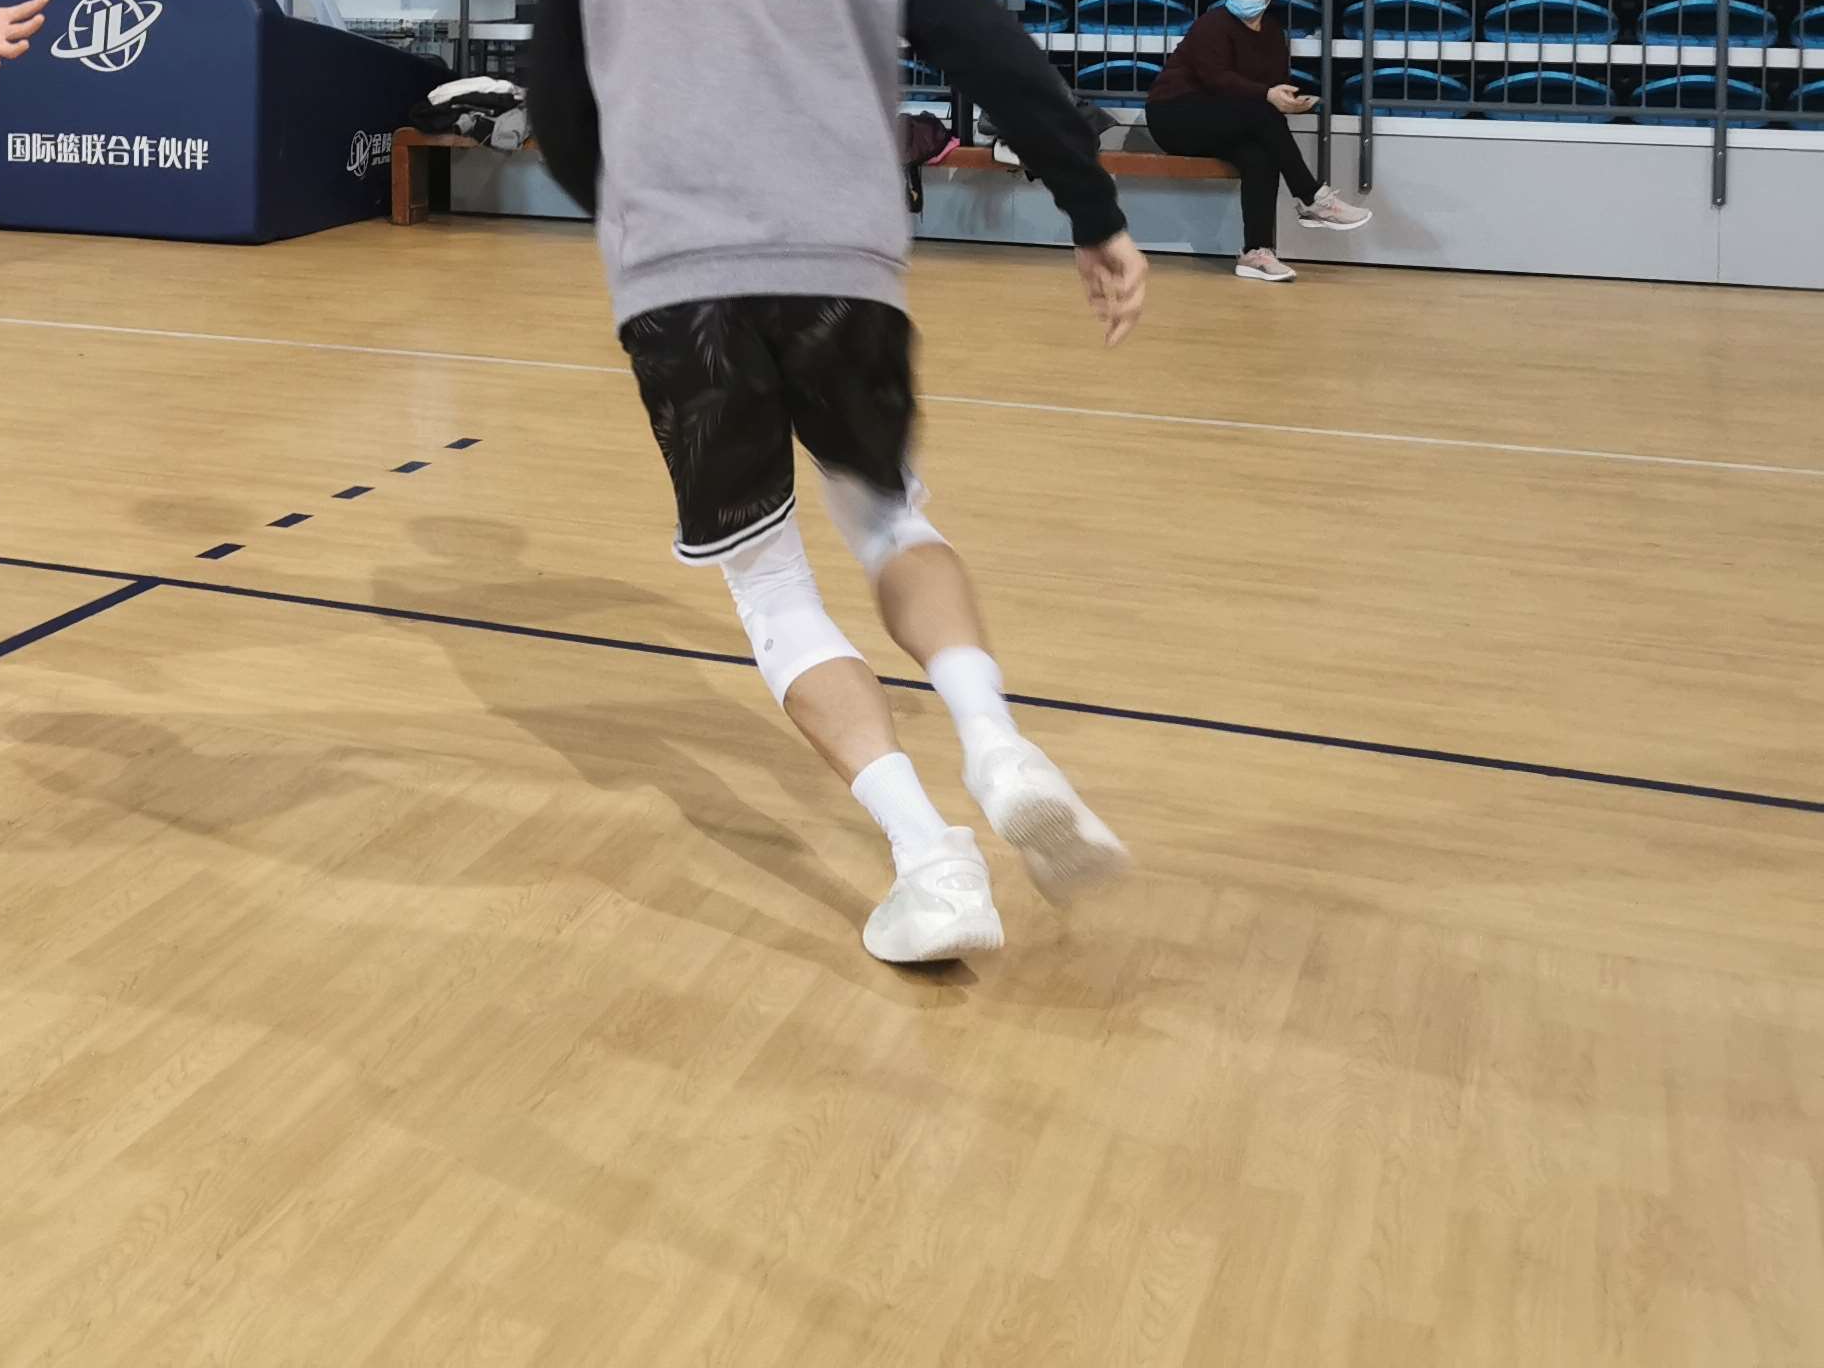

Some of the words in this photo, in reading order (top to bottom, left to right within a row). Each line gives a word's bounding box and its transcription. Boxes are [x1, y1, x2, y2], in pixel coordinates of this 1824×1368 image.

[7, 132, 209, 170] 国际篮联合作伙伴
